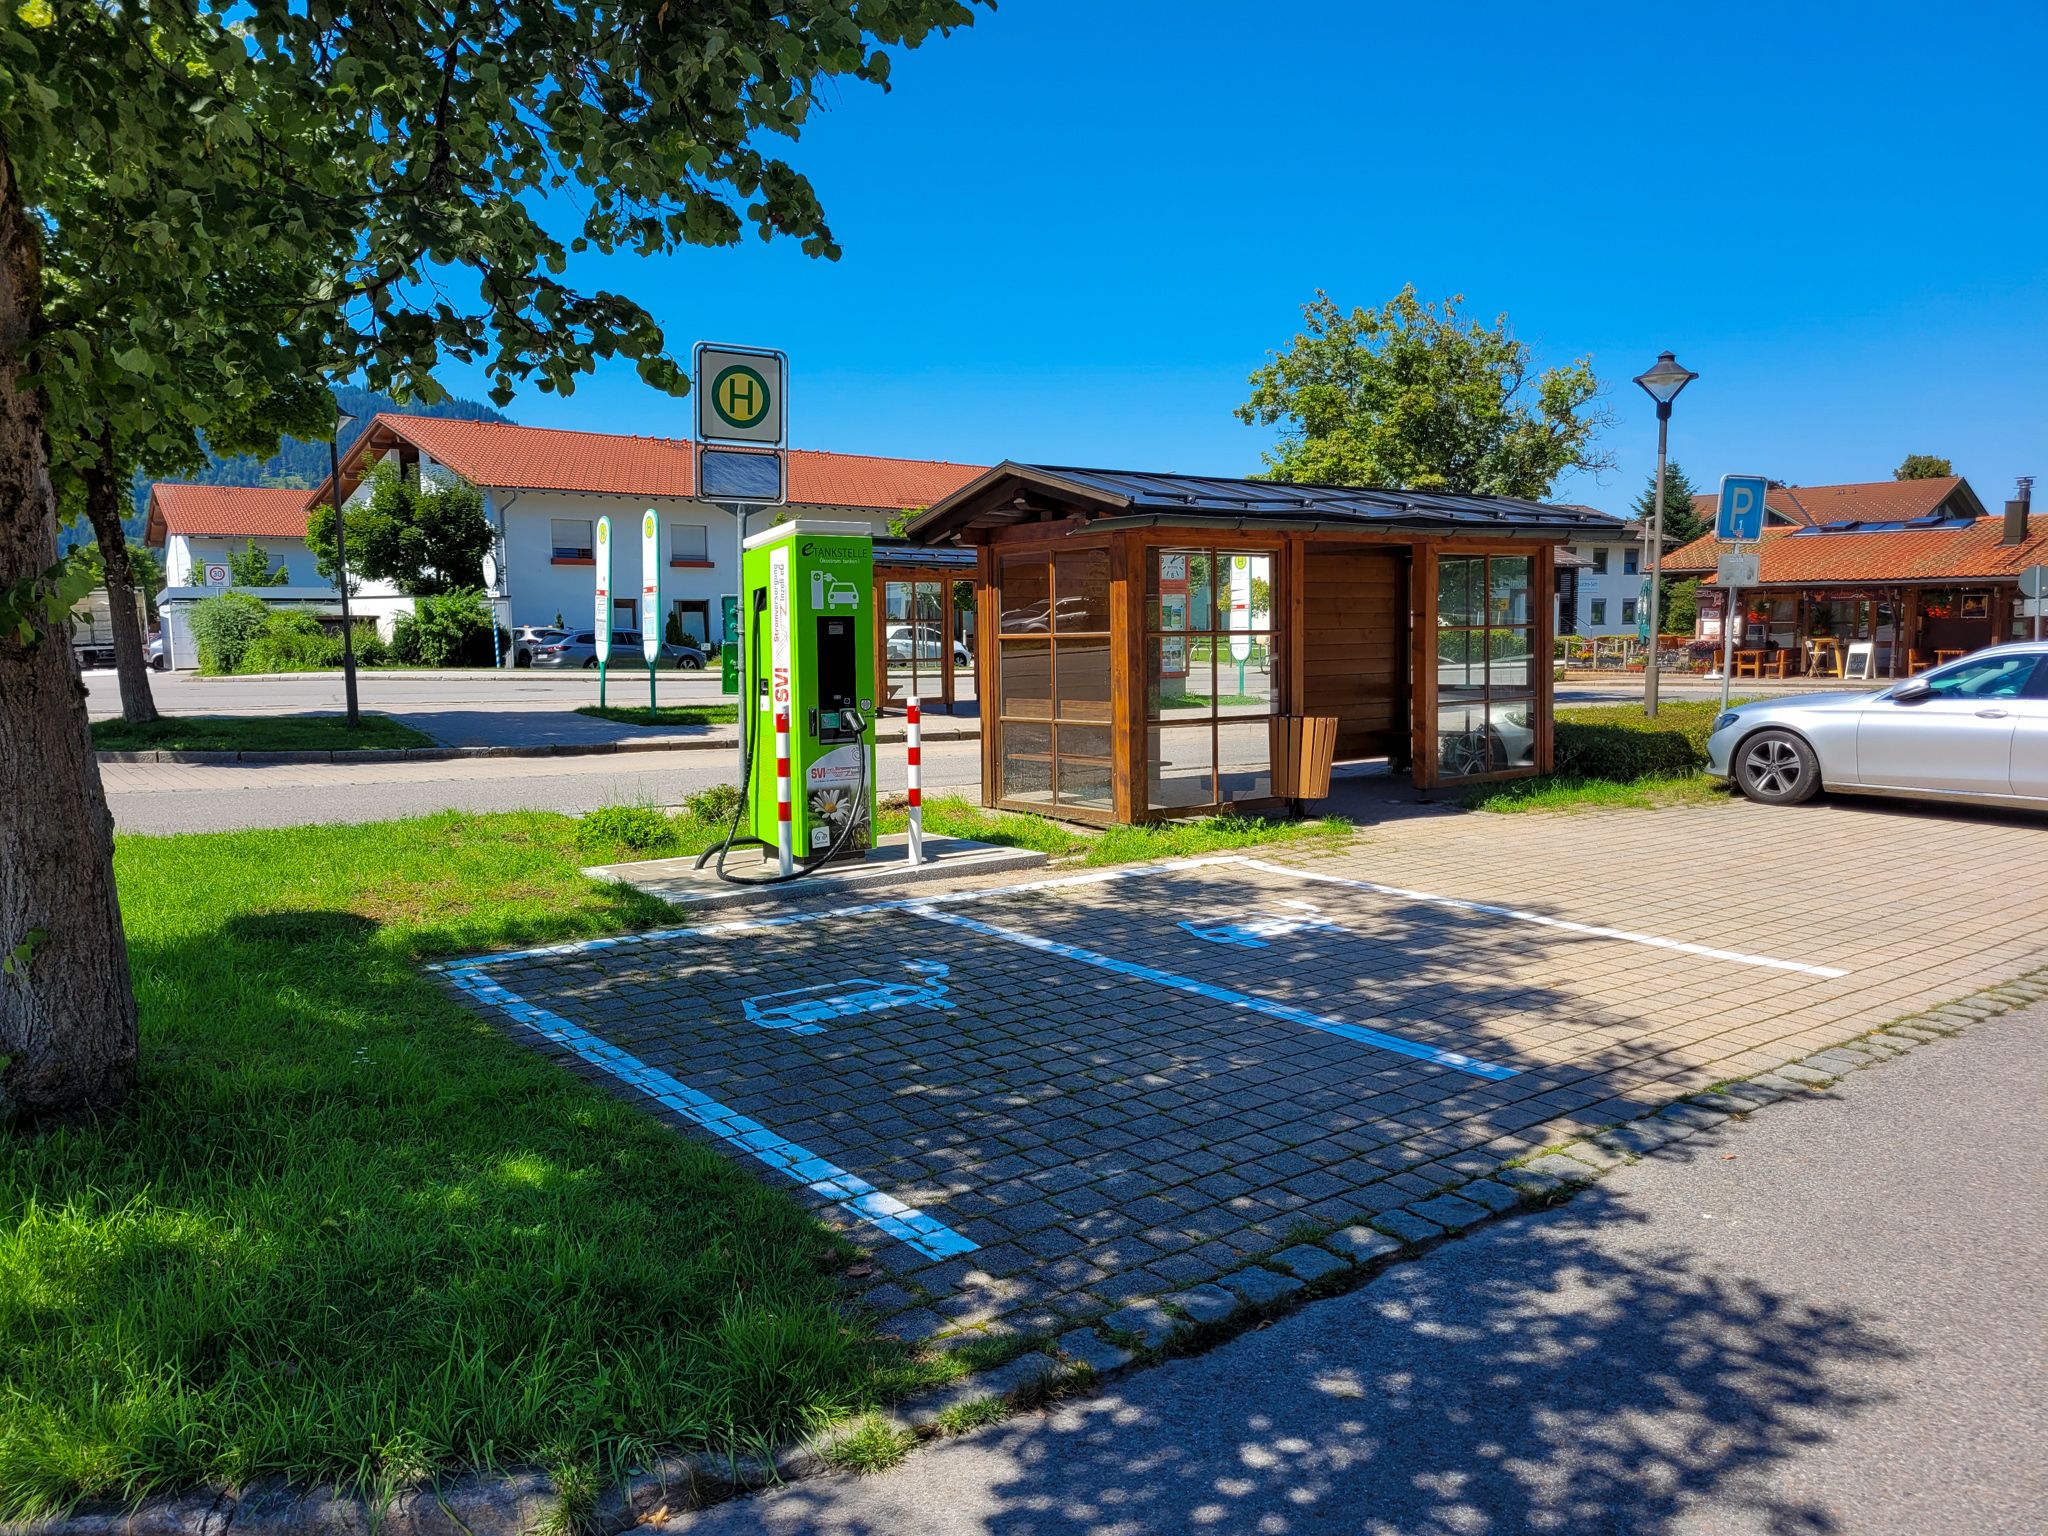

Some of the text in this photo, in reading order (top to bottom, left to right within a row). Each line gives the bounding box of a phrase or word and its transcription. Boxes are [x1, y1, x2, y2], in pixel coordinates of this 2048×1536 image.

[729, 378, 753, 415] H
[1730, 487, 1753, 530] P
[801, 542, 868, 558] eTANKSTELLE
[774, 667, 789, 703] SVI
[811, 767, 826, 779] SVI
